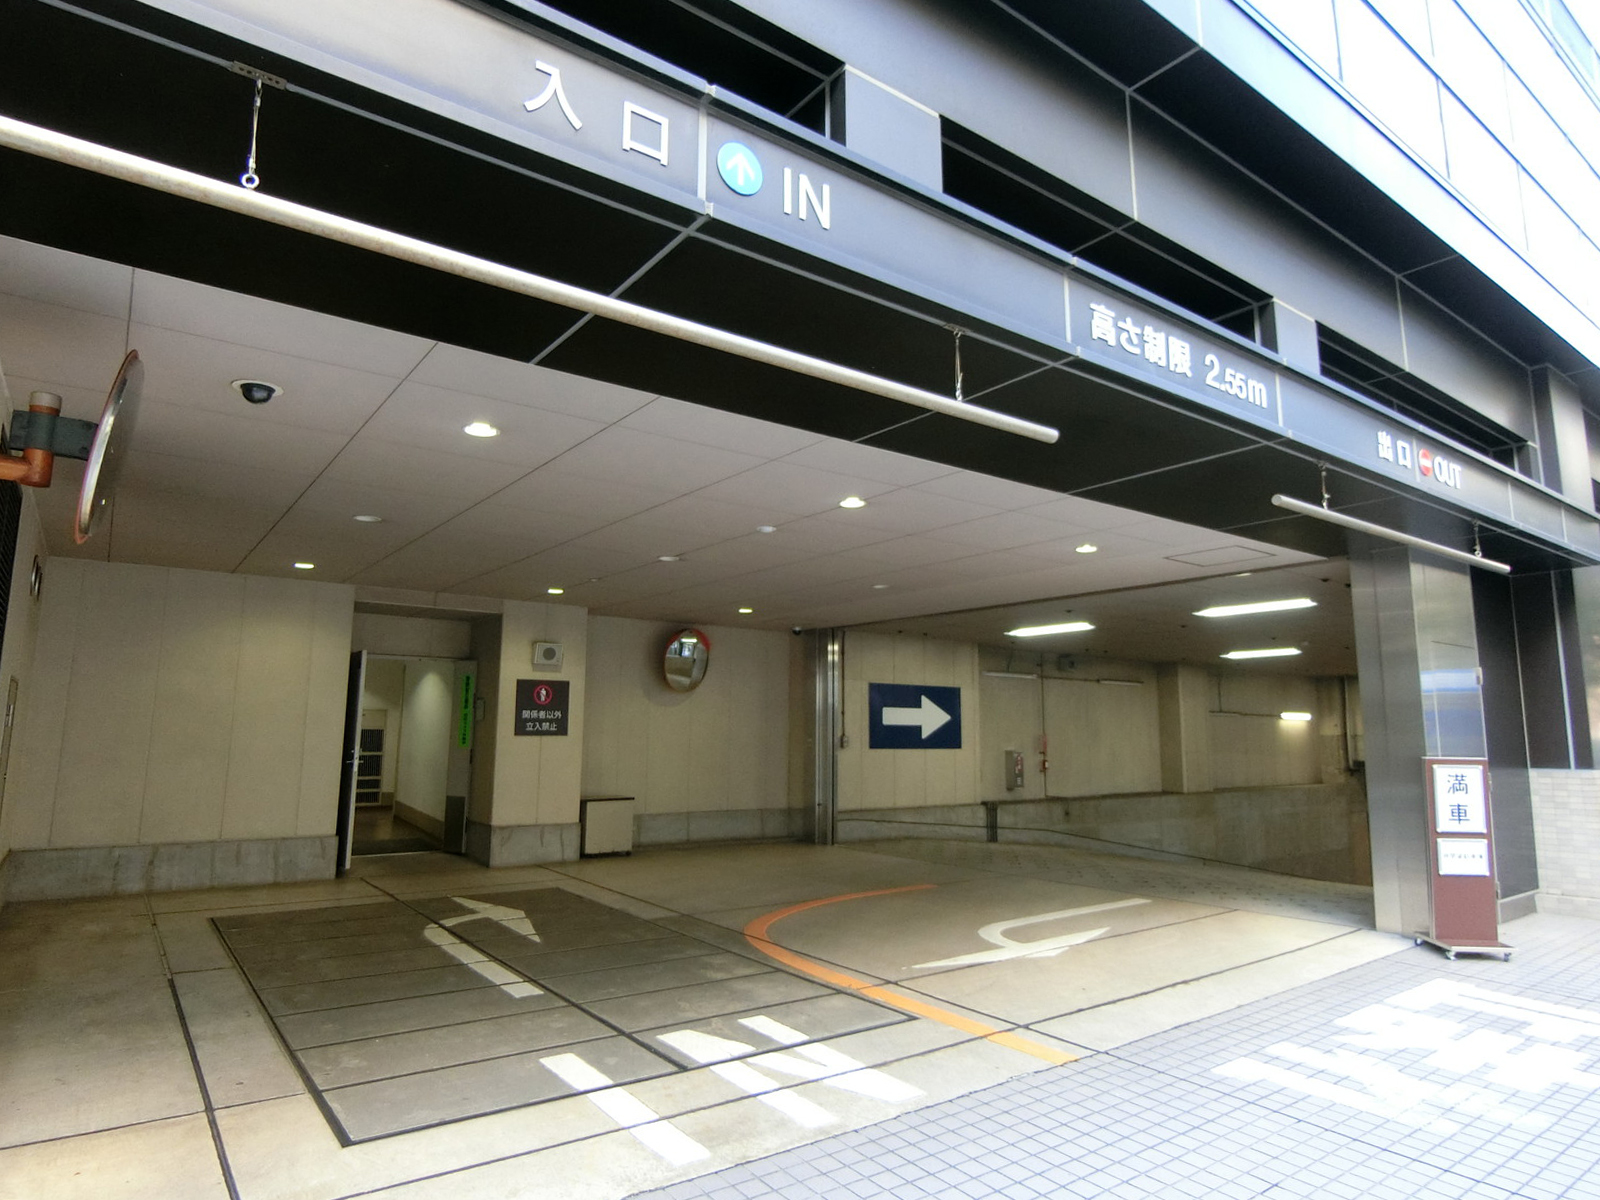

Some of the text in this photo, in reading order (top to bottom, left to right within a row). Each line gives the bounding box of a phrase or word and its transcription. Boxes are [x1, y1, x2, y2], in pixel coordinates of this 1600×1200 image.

[523, 59, 831, 230] 入口 IN
[1089, 302, 1268, 409] 高さ制限 2.55m
[1377, 431, 1462, 489] 出口 OUT
[522, 709, 562, 719] 関係者以外
[525, 721, 558, 731] 立入禁止
[1447, 773, 1471, 825] 満車
[539, 1014, 927, 1167] IN
